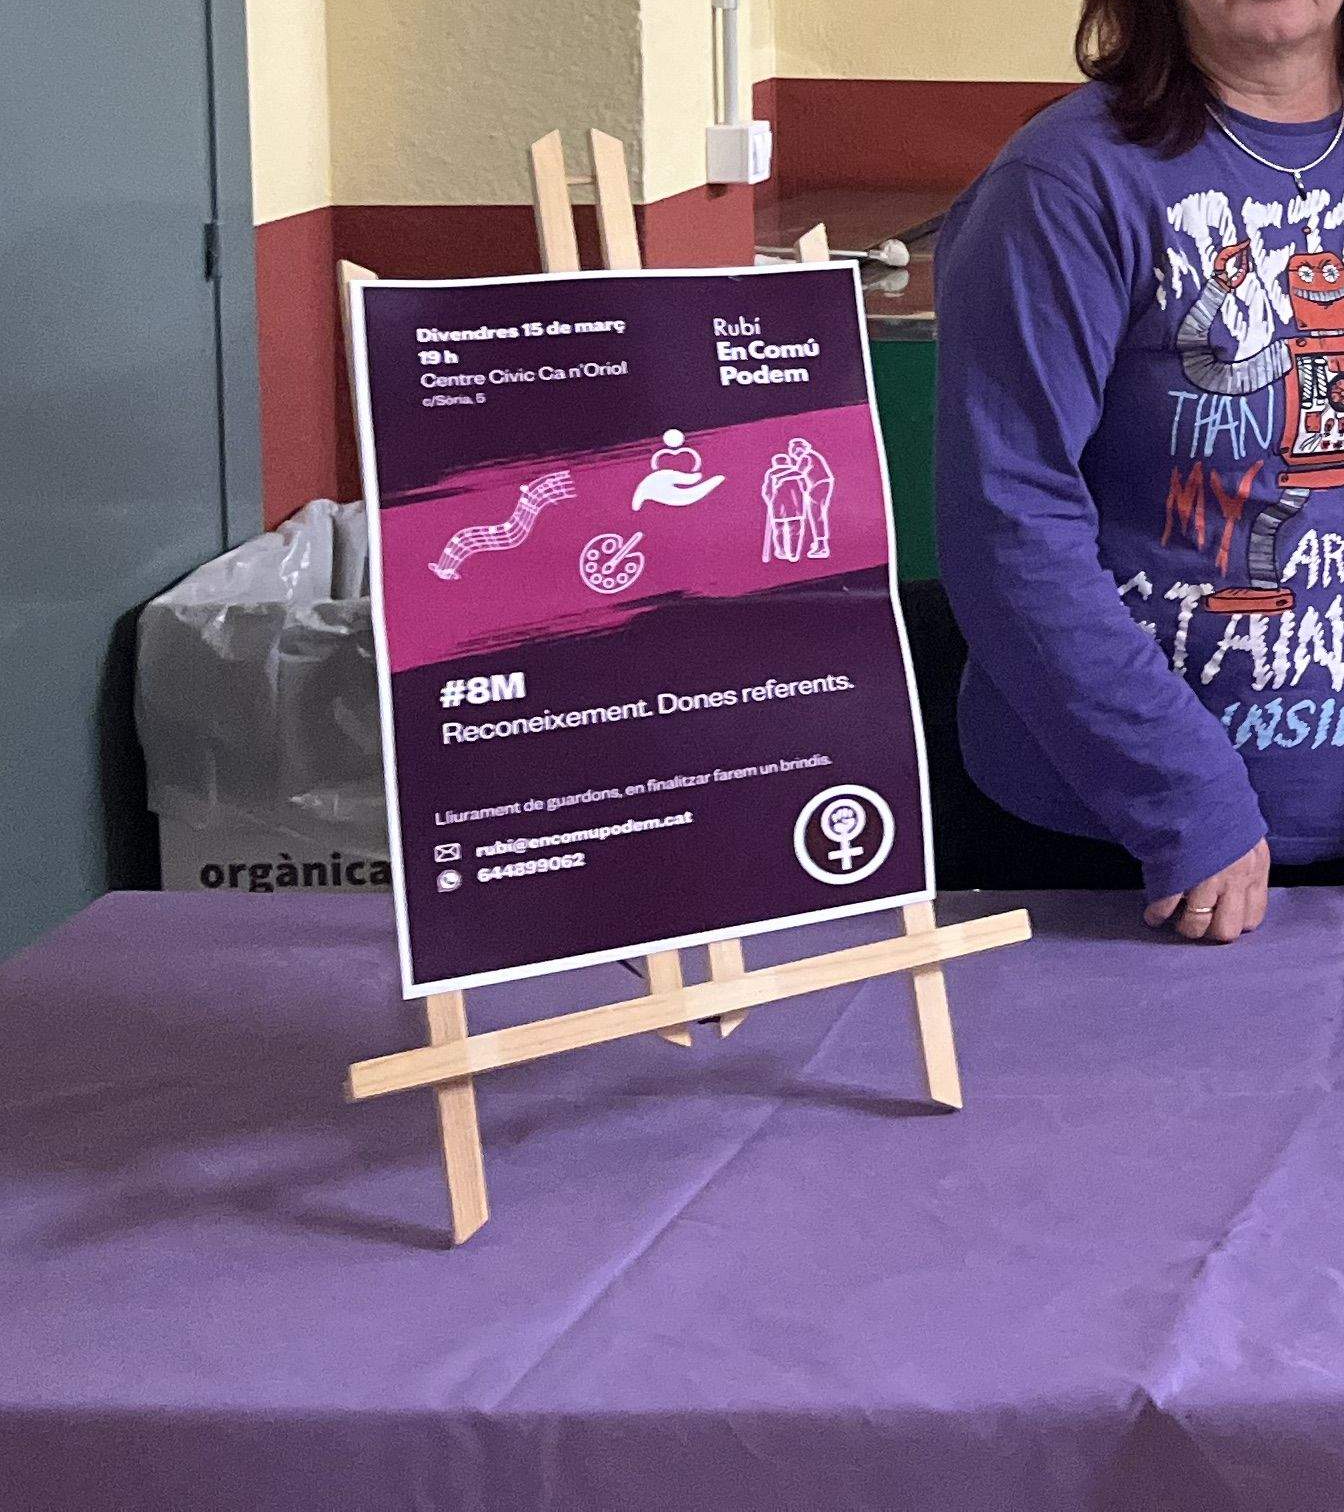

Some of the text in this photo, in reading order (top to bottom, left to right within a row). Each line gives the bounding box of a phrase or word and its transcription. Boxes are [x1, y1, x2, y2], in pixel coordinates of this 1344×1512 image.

[416, 320, 626, 343] Divendres 15 de març
[417, 350, 459, 365] 19 h
[420, 372, 487, 388] Centre
[538, 366, 567, 381] Ca
[569, 361, 629, 378] n'Oriol
[720, 364, 810, 386] Podem
[476, 393, 487, 404] 5
[1168, 381, 1274, 460] THAN
[1160, 461, 1265, 578] MY
[439, 672, 527, 708] #8M
[442, 674, 855, 745] Reconeixement. Dones referents.
[435, 753, 833, 826] Lliurament de guardons, en finalitzar farem un brindis.
[475, 811, 693, 858] rubi@encomupodem.cat
[200, 852, 392, 893] orgànica
[477, 852, 587, 883] 644899062
